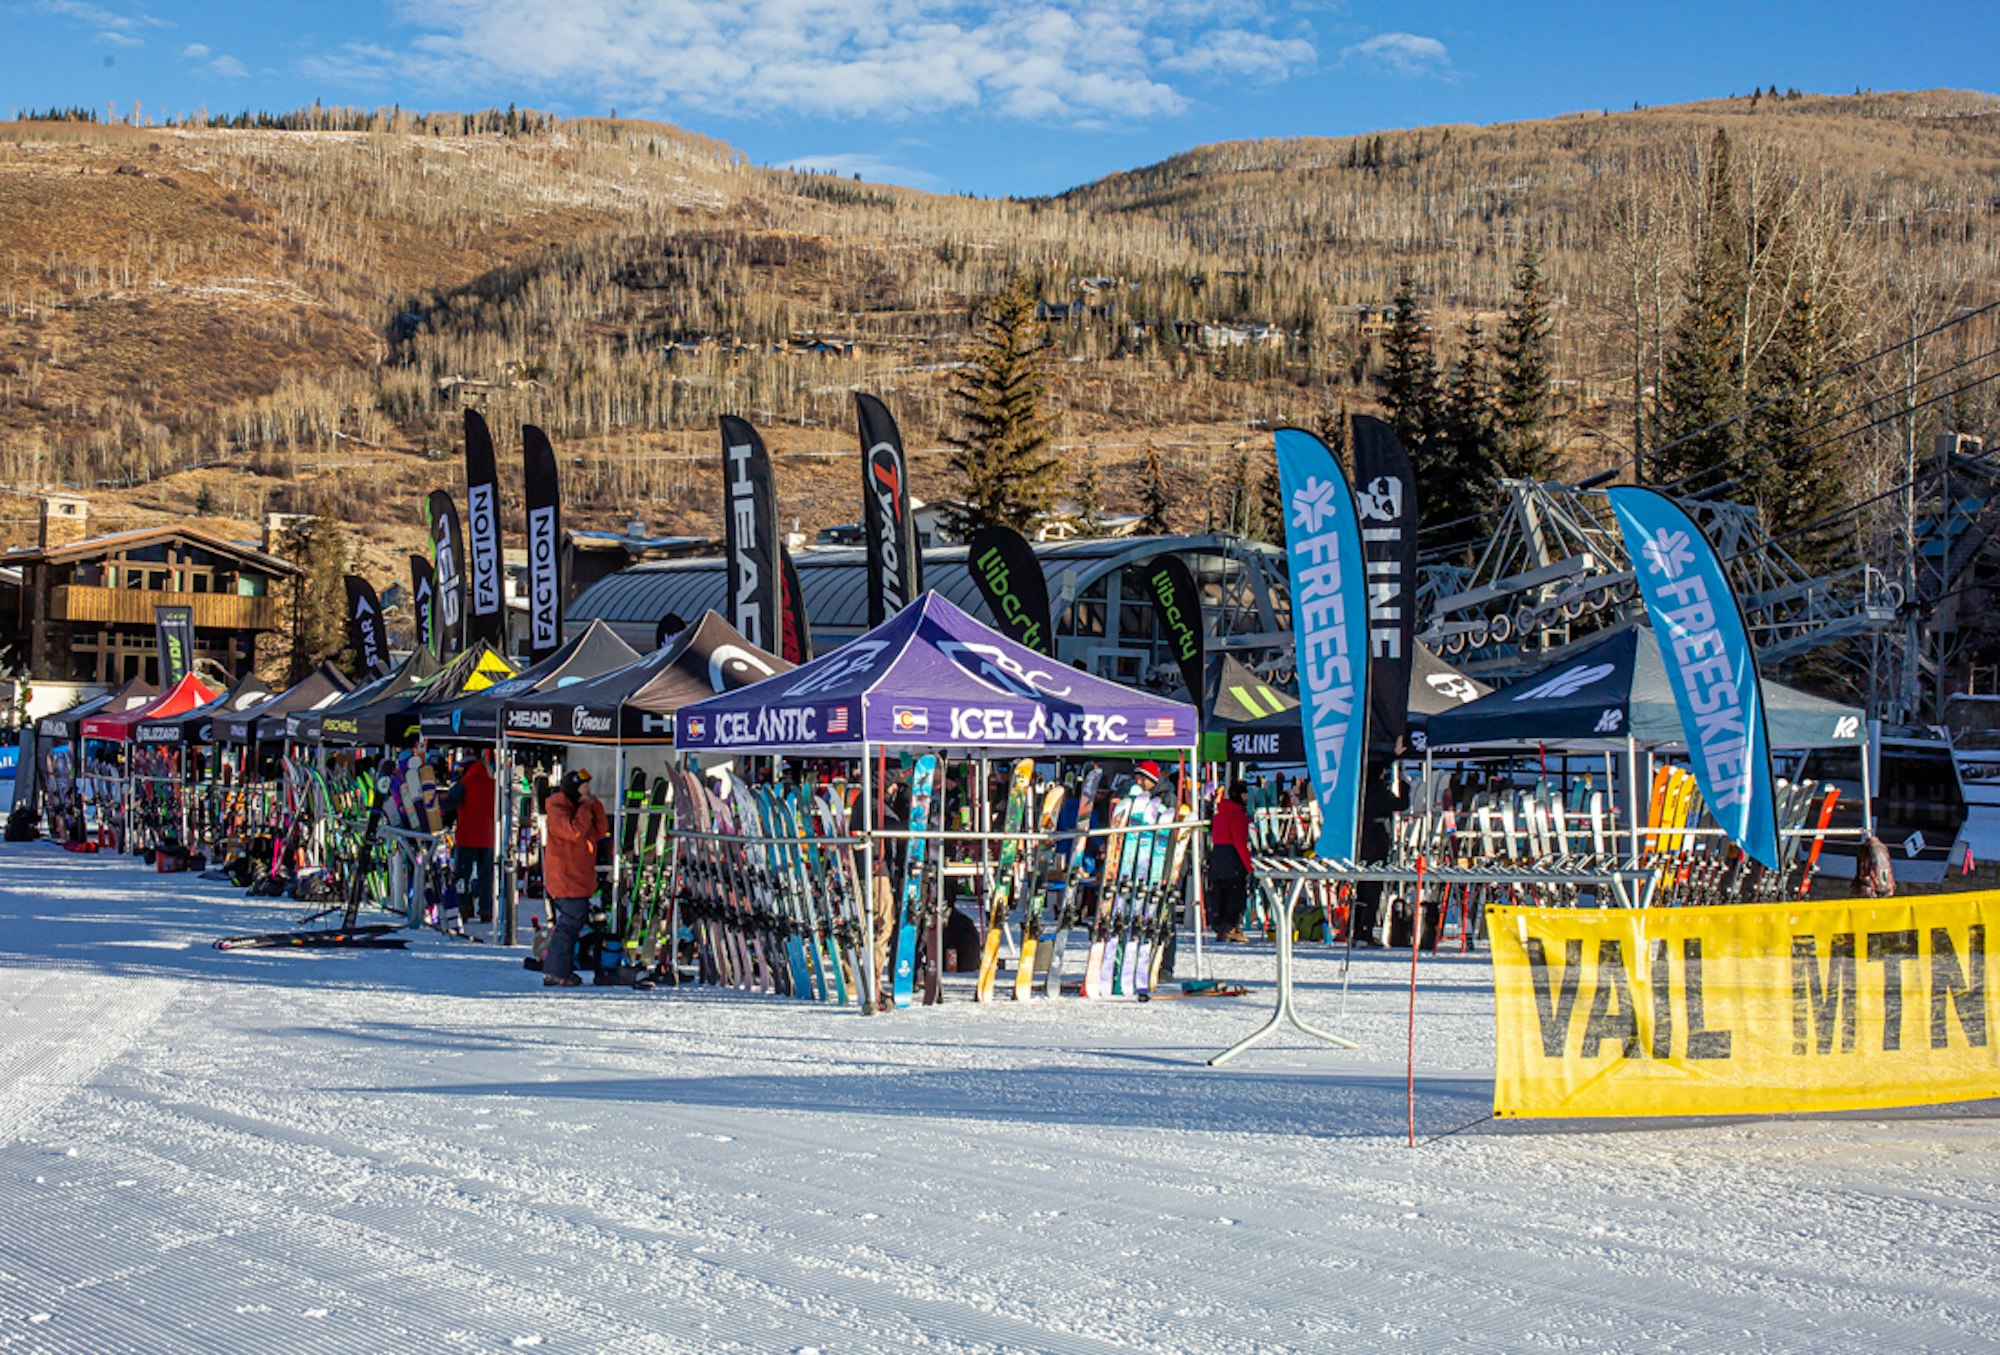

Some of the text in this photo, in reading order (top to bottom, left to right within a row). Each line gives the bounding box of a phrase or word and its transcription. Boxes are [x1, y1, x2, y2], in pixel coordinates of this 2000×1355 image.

[474, 491, 495, 608] FACTION
[729, 444, 762, 646] HEAD
[535, 515, 553, 642] FACTION
[1656, 574, 1754, 810] FREESKIER
[508, 710, 552, 729] HEAD
[714, 704, 817, 745] ICELANTIC
[950, 704, 1128, 742] ICELANTIC
[1593, 708, 1623, 732] K2
[1832, 715, 1859, 738] K2
[1244, 733, 1280, 754] LINE
[1527, 924, 1988, 1060] VAIL MTN
